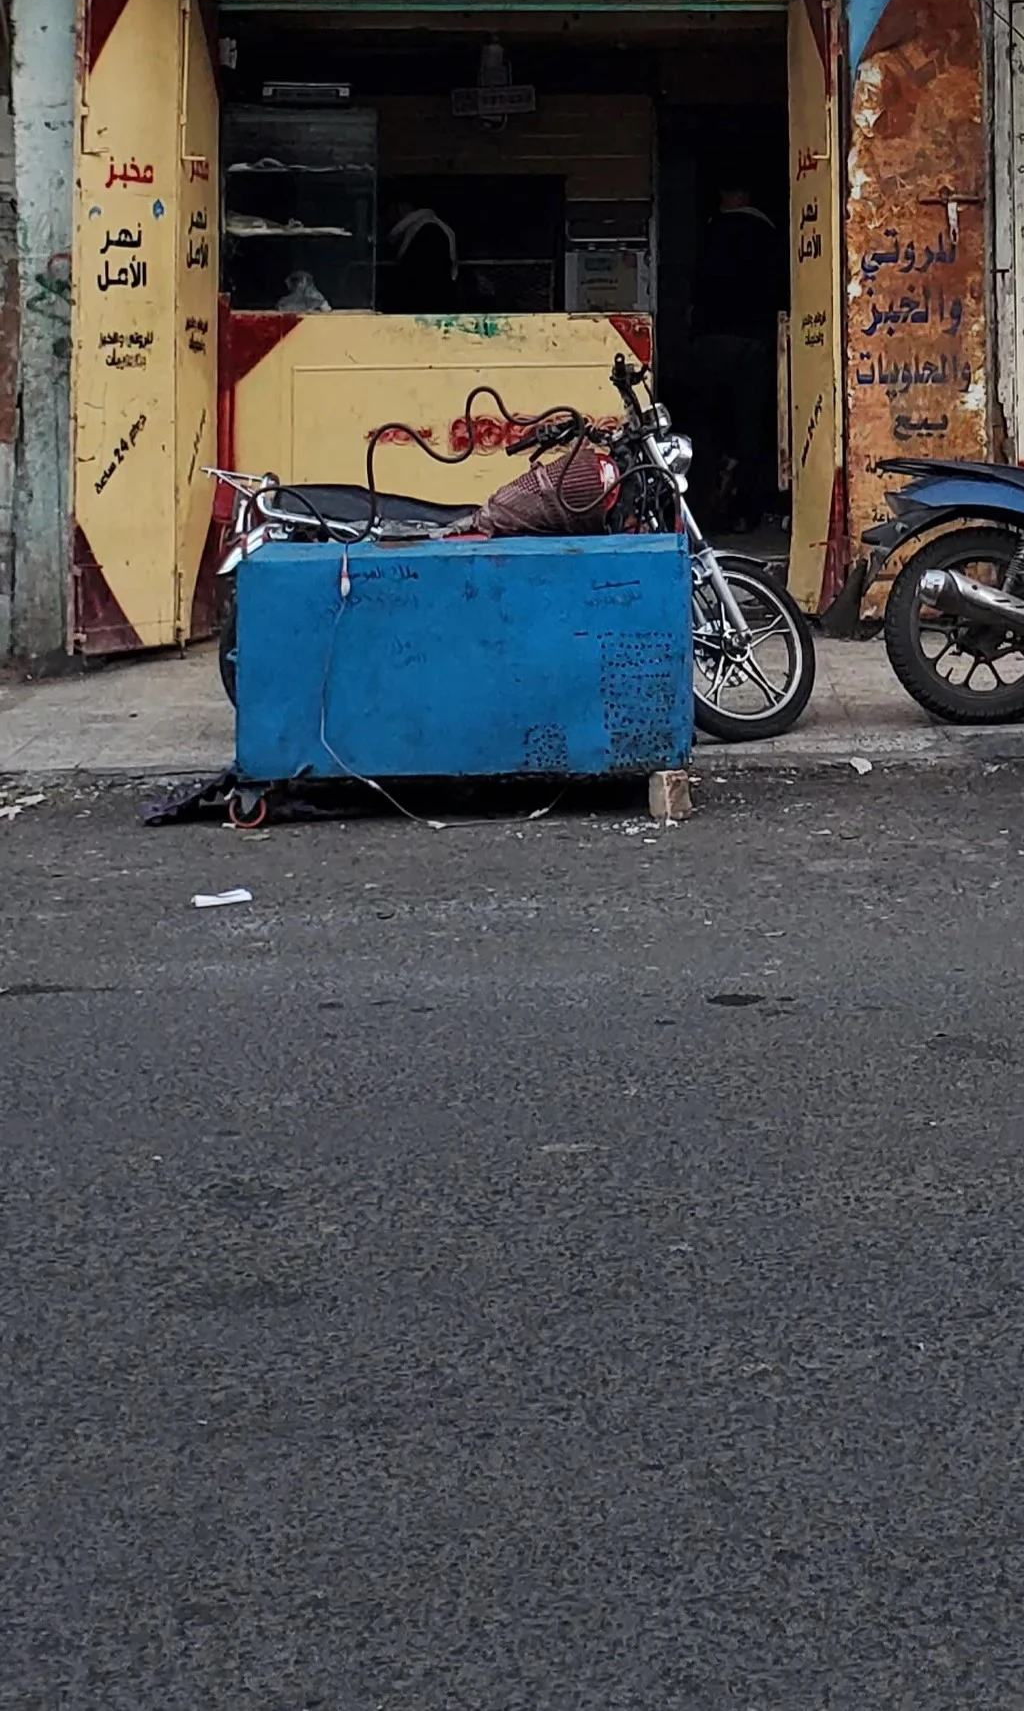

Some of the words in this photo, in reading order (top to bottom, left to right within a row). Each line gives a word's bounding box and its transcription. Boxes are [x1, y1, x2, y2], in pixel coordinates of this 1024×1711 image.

[105, 156, 154, 189] مخبز
[100, 222, 142, 254] نهر
[97, 255, 148, 292] الأمل
[861, 282, 963, 337] والخبز
[113, 437, 130, 465] 24
